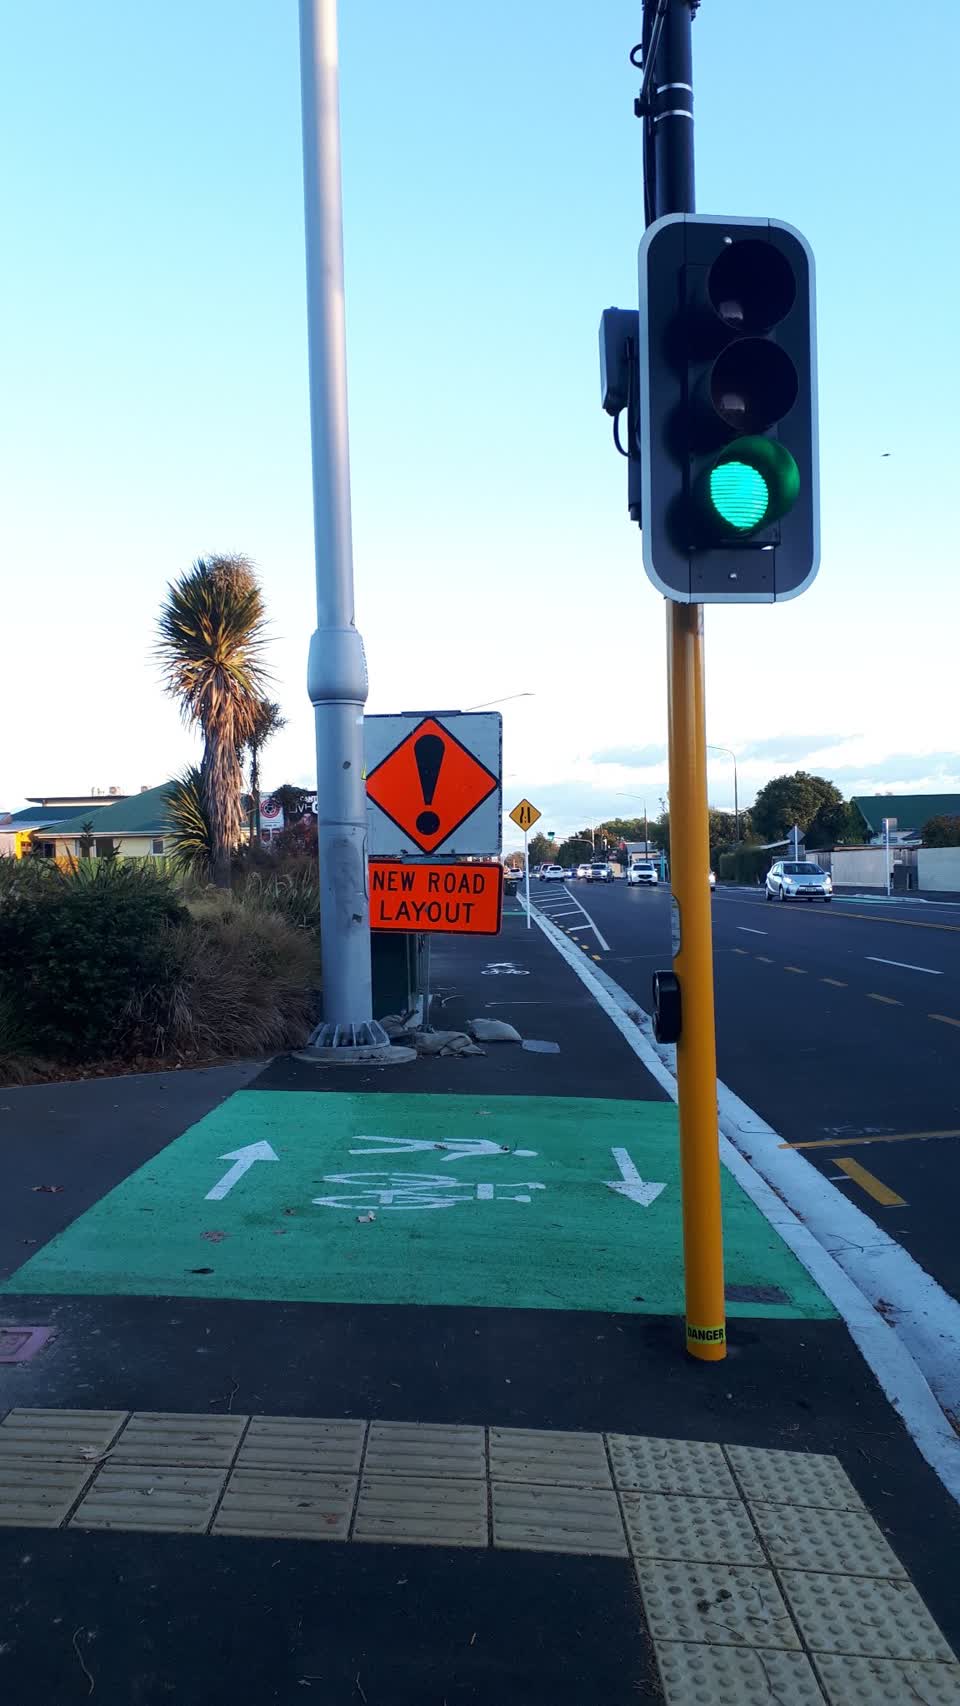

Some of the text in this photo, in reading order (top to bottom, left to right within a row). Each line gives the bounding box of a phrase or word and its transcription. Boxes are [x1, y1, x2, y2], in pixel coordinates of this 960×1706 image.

[372, 870, 486, 894] NEW ROAD
[380, 899, 475, 924] LAYOUT
[687, 1326, 724, 1341] DANGER
